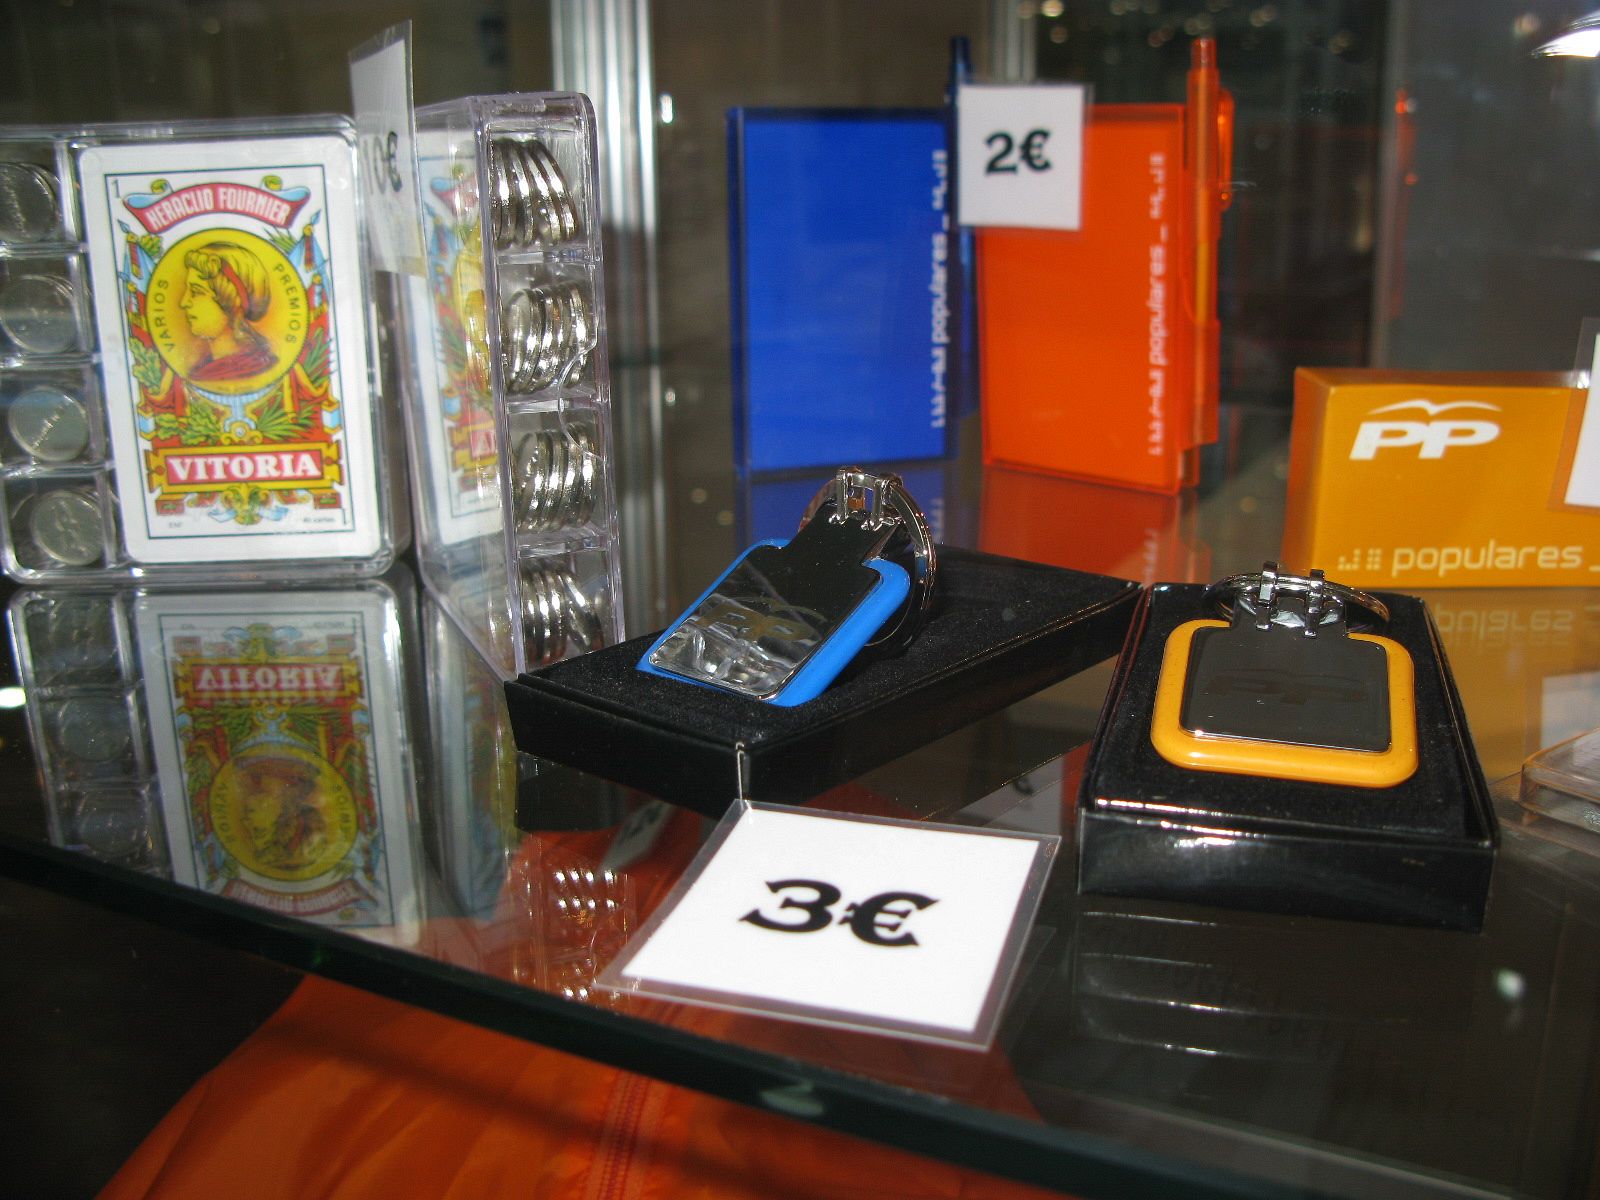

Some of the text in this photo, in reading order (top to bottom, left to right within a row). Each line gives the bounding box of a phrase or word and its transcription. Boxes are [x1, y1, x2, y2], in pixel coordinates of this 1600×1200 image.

[984, 129, 1053, 175] 2€
[144, 187, 291, 230] HERACLIO FOURNIER
[154, 280, 176, 351] VARIOS
[274, 263, 300, 343] PREMIOS
[169, 453, 322, 480] VITORIA
[1392, 539, 1583, 578] populares
[738, 878, 940, 947] 3€
